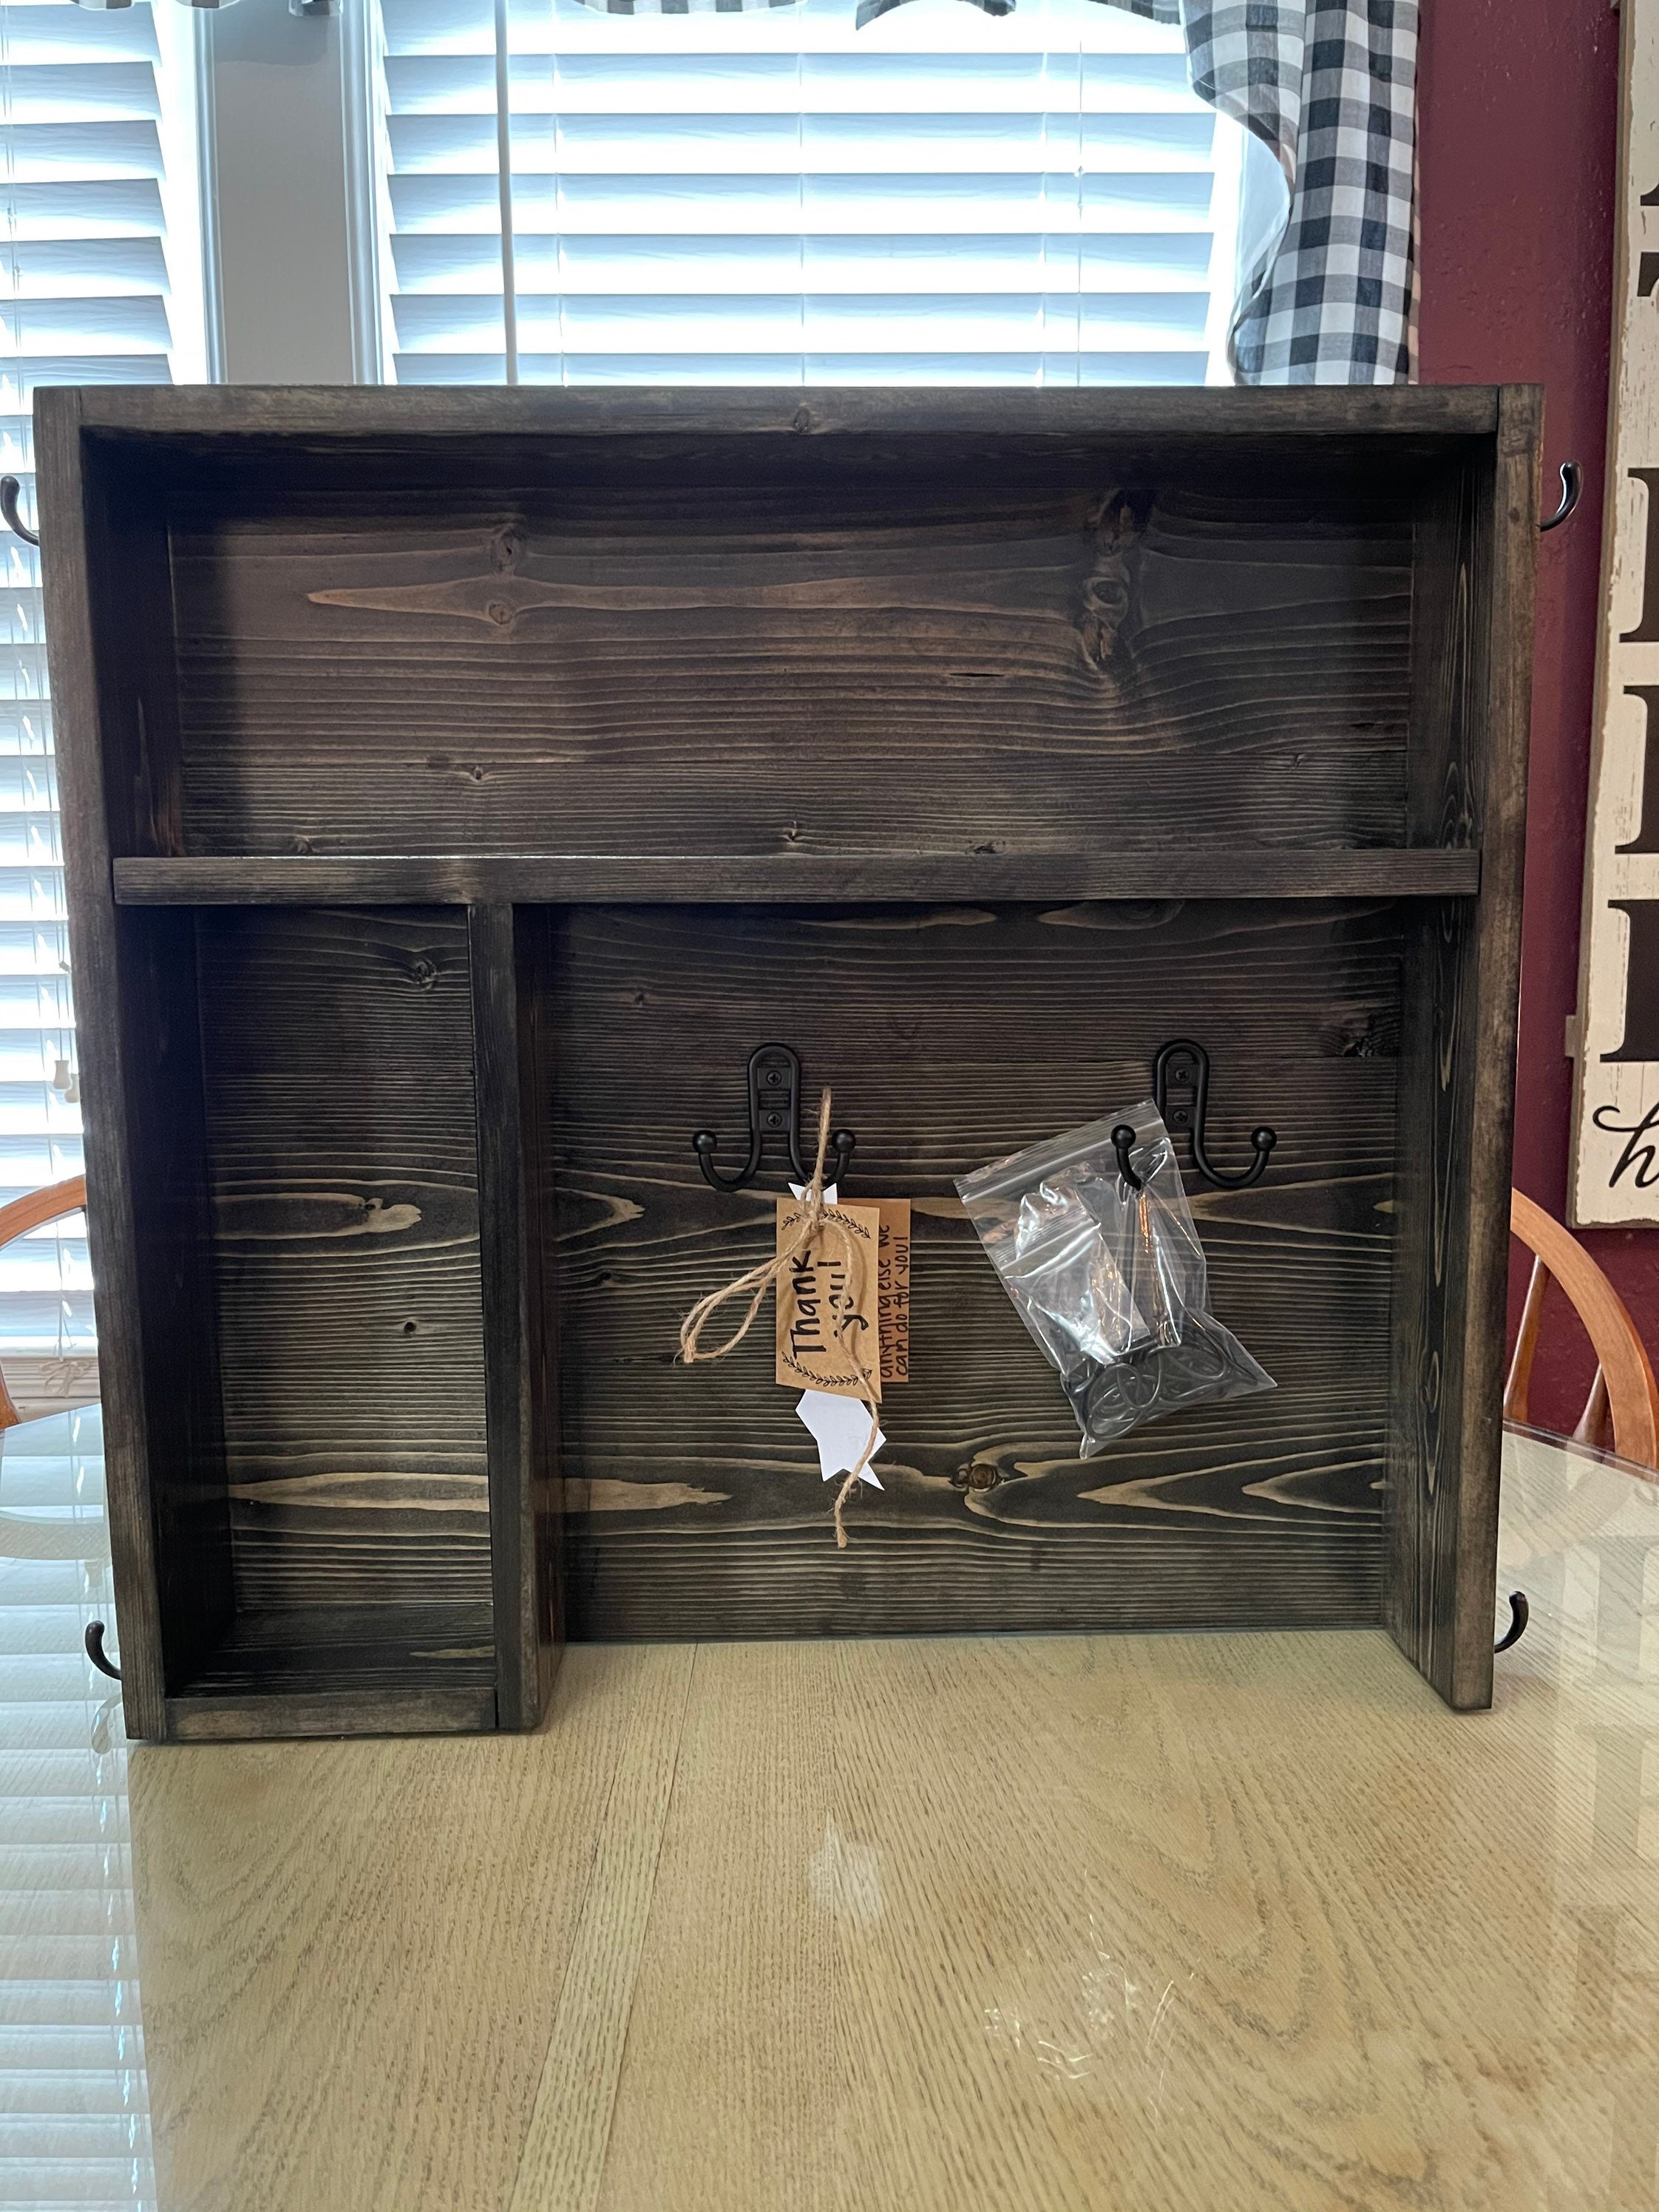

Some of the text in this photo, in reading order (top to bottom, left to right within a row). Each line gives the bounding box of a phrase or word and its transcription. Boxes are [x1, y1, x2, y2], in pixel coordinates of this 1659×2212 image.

[789, 1250, 827, 1360] Thank
[817, 1261, 869, 1337] you!
[893, 1236, 909, 1376] can do for you!
